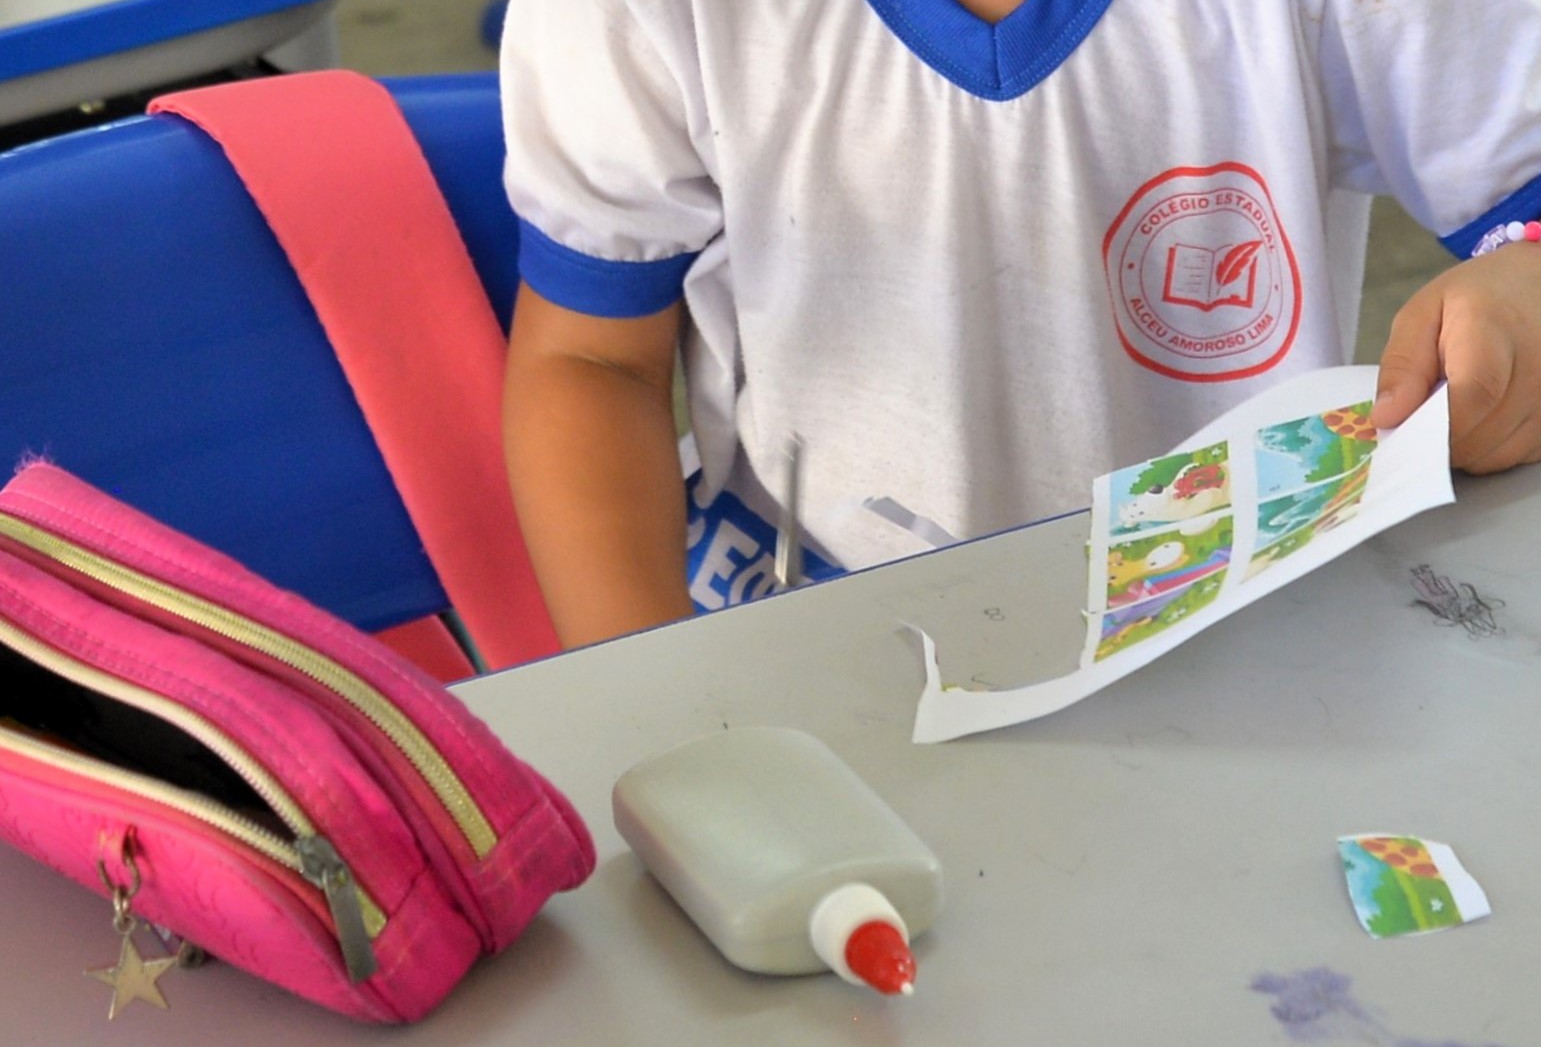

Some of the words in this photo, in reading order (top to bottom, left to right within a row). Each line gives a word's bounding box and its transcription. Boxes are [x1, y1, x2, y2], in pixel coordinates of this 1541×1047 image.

[1215, 193, 1275, 253] ESTADUAL
[1130, 297, 1167, 339] ALCEU
[1168, 334, 1246, 353] AMOROSO
[1248, 313, 1274, 340] LIMA
